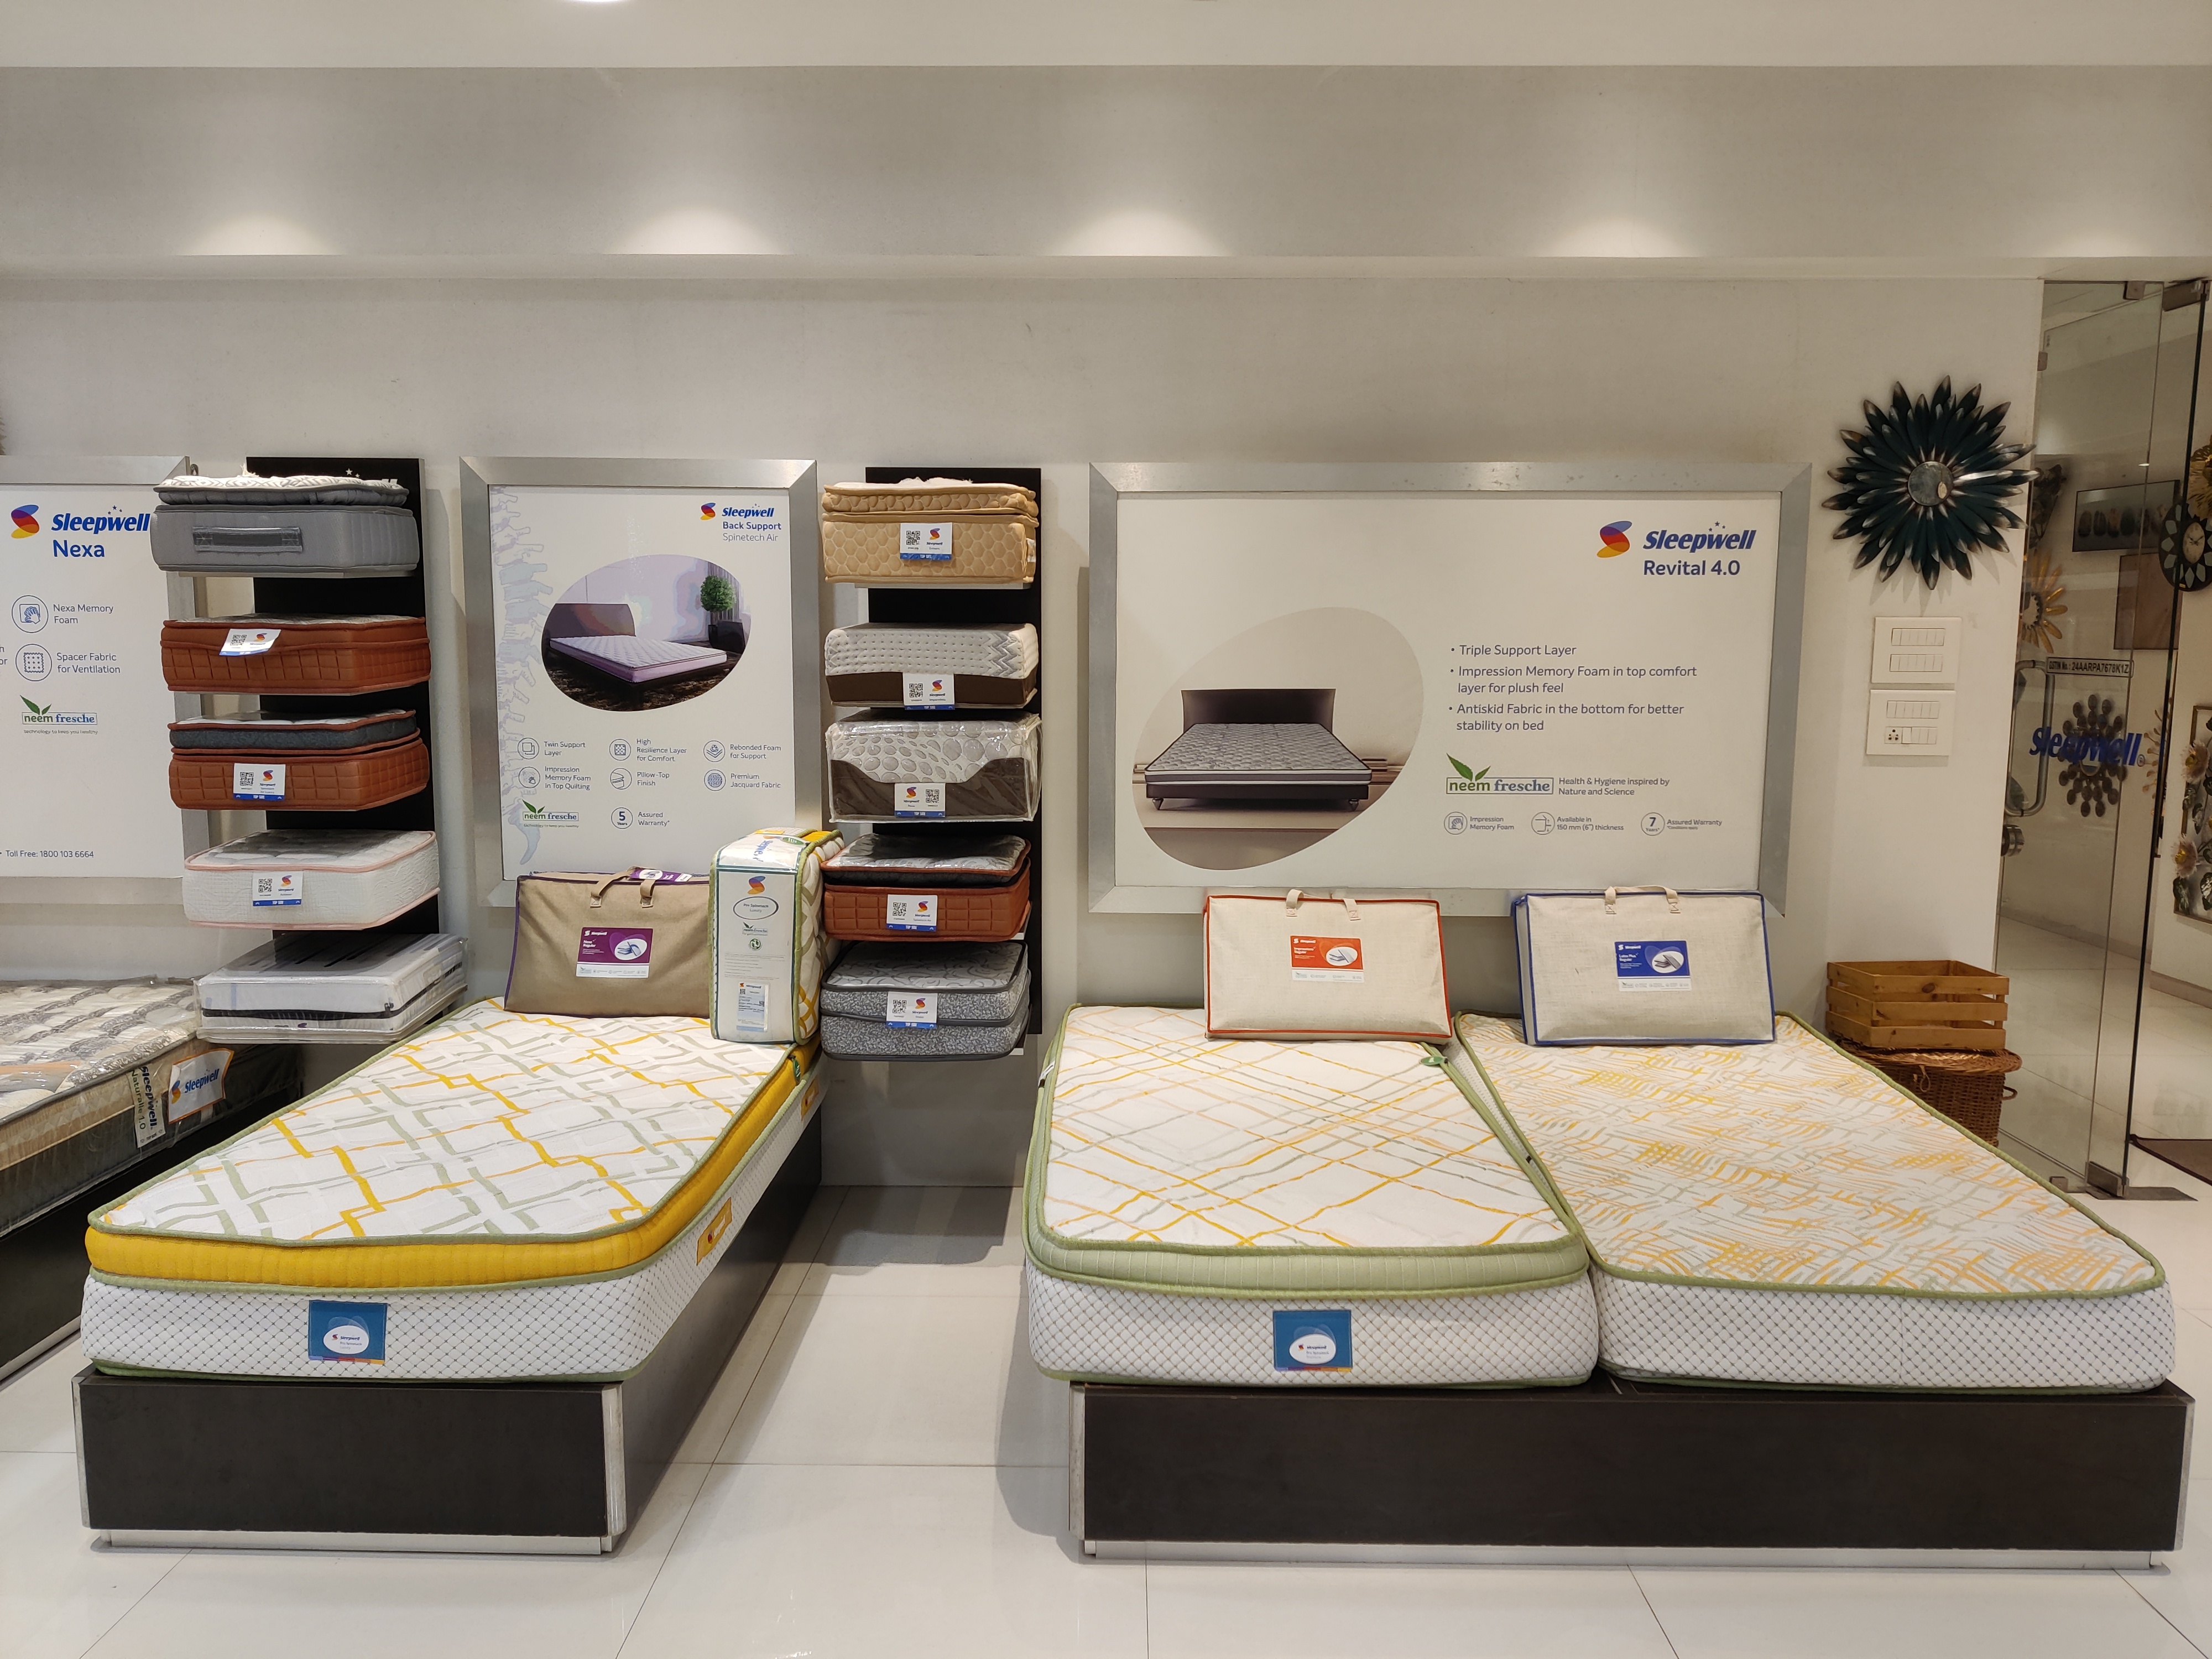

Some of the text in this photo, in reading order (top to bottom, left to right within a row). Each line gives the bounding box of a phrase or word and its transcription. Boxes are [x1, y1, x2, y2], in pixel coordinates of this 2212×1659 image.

[722, 507, 775, 519] Sleepwell
[51, 513, 150, 534] Sleepwell
[747, 521, 781, 531] Support
[723, 533, 765, 542] Spinetech
[1642, 529, 1757, 553] Sleepwell
[53, 540, 105, 557] Nexa
[1644, 560, 1740, 576] Revital 4.0
[53, 604, 114, 614] Nexa Memory
[54, 616, 78, 624] Foam
[1459, 645, 1577, 658] Triple Support Layer
[56, 653, 117, 662] Spacer Fabric
[58, 665, 121, 674] for Ventilation
[1458, 666, 1697, 679] Impression Memory Foam in top comfort
[1458, 682, 1564, 695] layer for plush feel
[1457, 704, 1684, 714] Antiskid Fabric in the bottom for better
[24, 713, 95, 723] neem fresche
[1456, 721, 1544, 732] stability on bed
[1449, 779, 1550, 791] neem fresche
[1660, 778, 1670, 786] by
[619, 811, 625, 821] 5
[1649, 817, 1656, 827] 7
[185, 1068, 220, 1093] Sleepwell
[139, 1066, 158, 1127] Sleepwell
